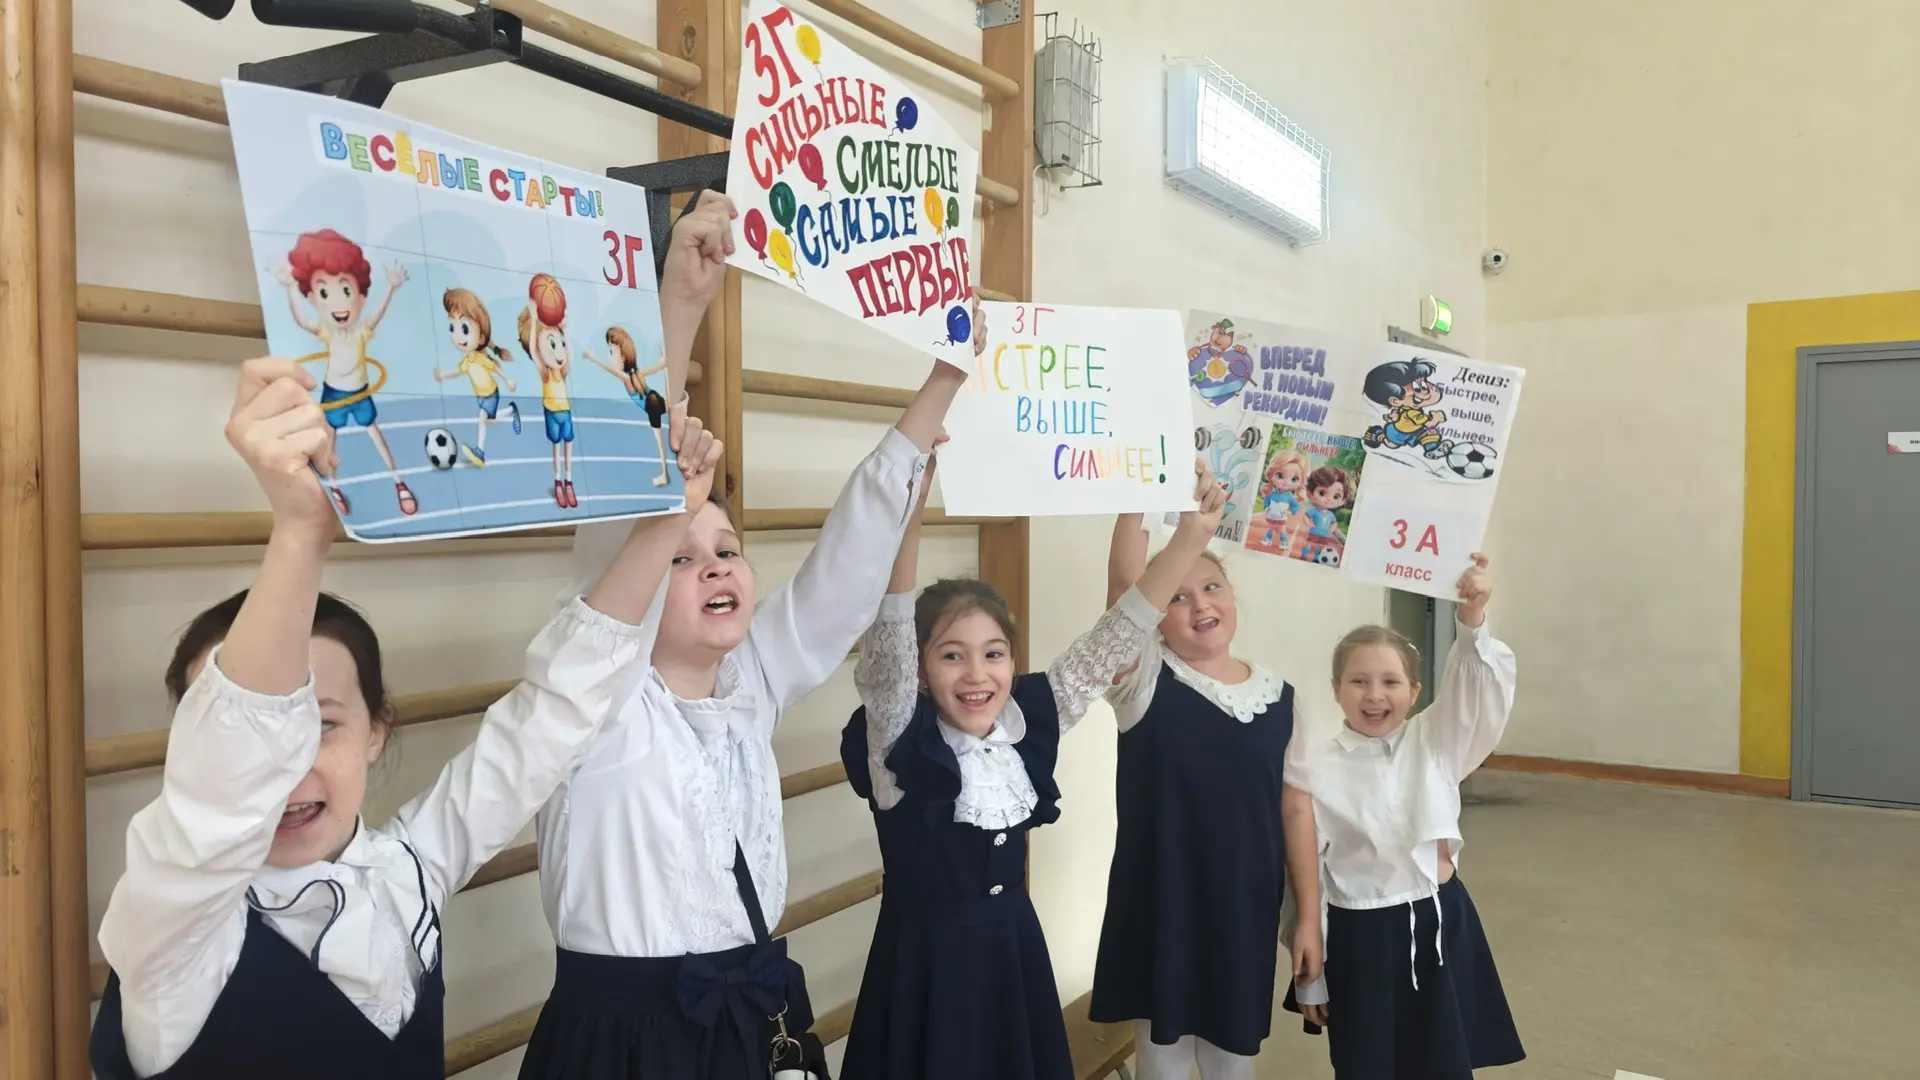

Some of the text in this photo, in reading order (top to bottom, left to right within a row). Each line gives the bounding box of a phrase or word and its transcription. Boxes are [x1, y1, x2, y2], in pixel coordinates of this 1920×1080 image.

[745, 77, 887, 189] СИЛЬНЫЕ
[320, 122, 604, 219] ВЕСЁЛЫЕ СТАРТЫ!
[836, 135, 958, 195] СМЕЛЫЕ
[797, 195, 918, 268] САМЫЕ
[846, 237, 972, 318] ПЕРВЫЕ
[963, 342, 1112, 393] ЫСТРЕЕ,
[1260, 346, 1327, 378] ВПЕРЕД
[1452, 367, 1510, 388] Девиз:
[1262, 372, 1335, 402] К НОВЫМ
[1243, 391, 1328, 426] РЕКОРДАМ!
[1450, 407, 1495, 427] выше,
[1437, 425, 1495, 445] ильнее»
[1389, 519, 1440, 556] 3 А
[1385, 563, 1432, 582] класс
